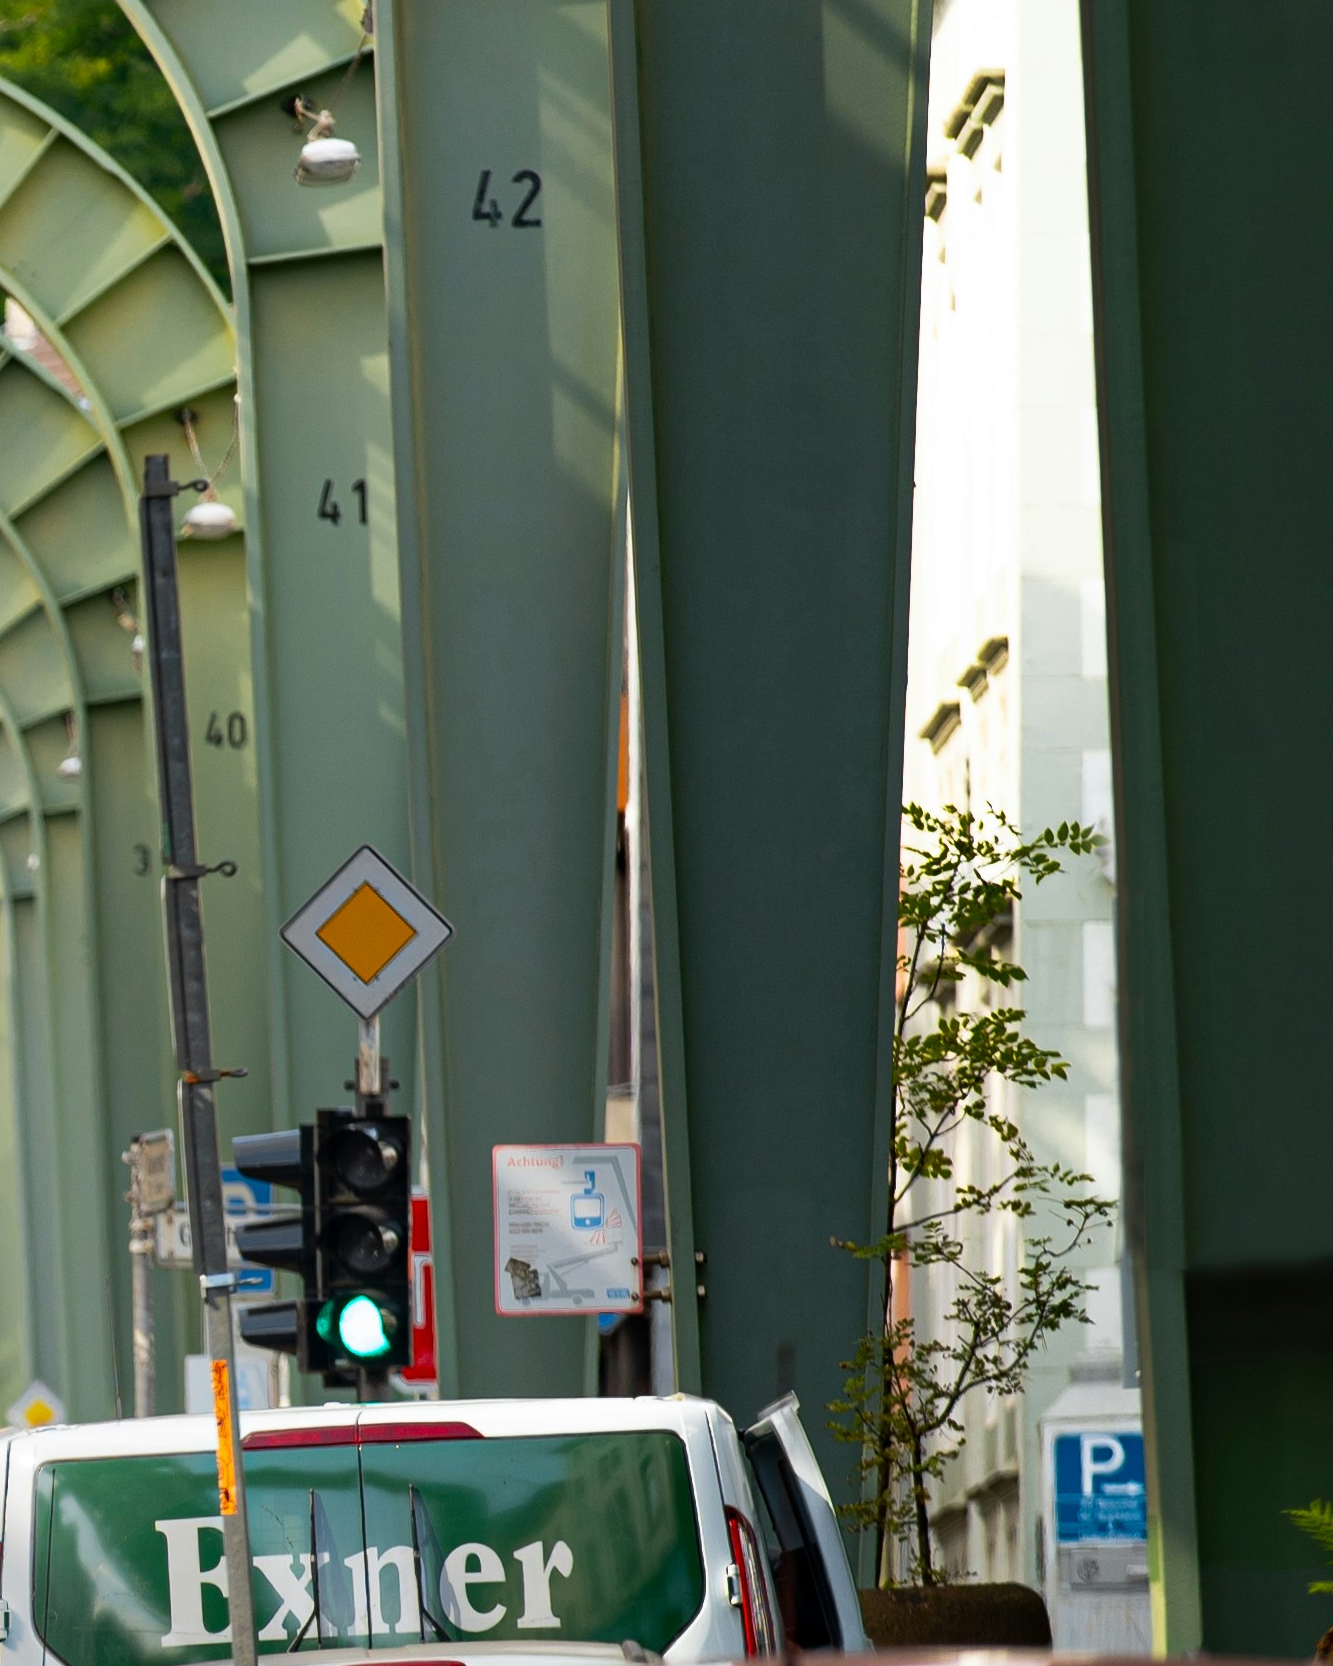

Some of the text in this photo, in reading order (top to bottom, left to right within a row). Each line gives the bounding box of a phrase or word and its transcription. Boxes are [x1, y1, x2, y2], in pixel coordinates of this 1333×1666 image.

[472, 170, 542, 229] 42
[317, 478, 368, 526] 41
[205, 710, 248, 750] 40
[1080, 1435, 1125, 1498] P
[155, 1515, 574, 1647] Exner
